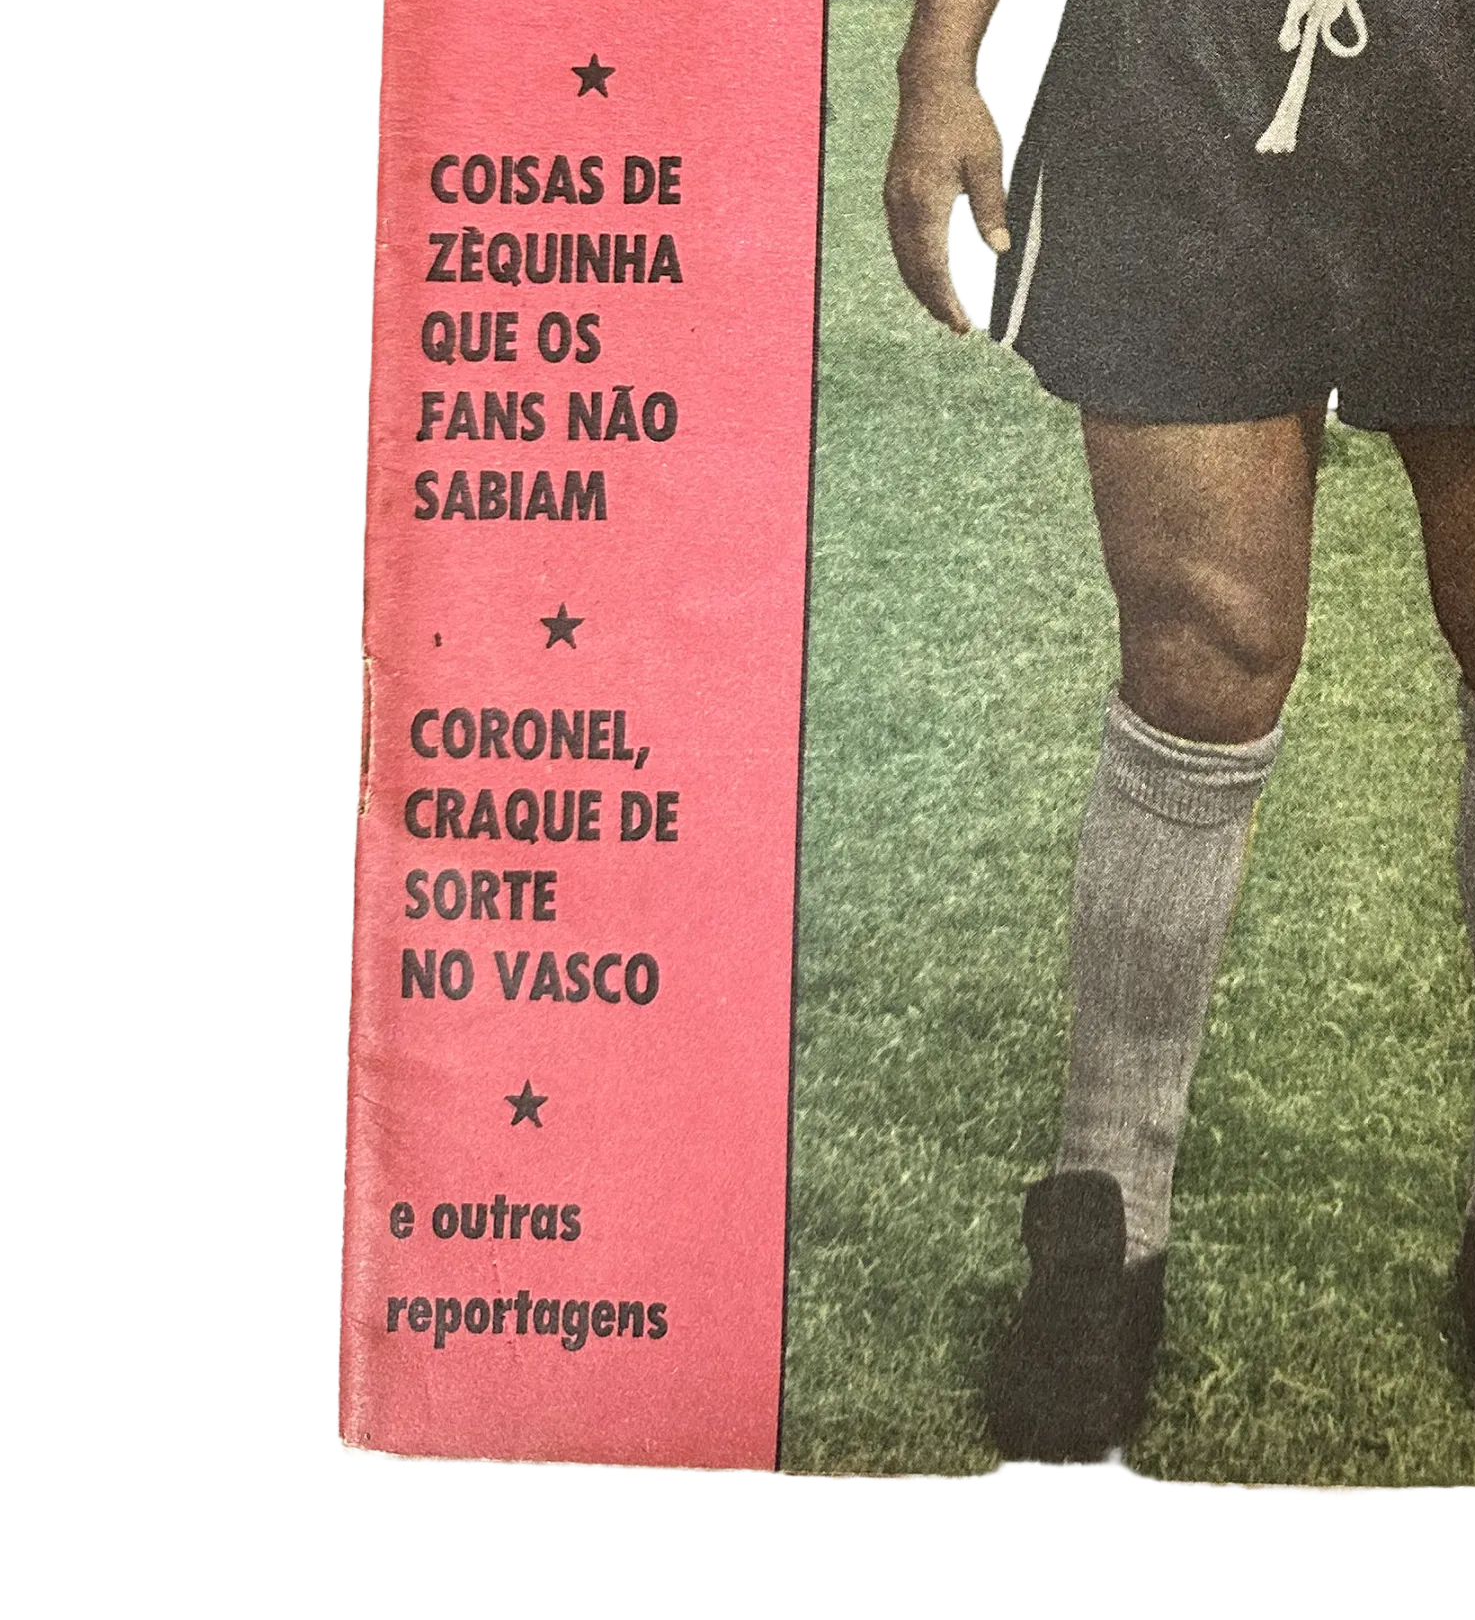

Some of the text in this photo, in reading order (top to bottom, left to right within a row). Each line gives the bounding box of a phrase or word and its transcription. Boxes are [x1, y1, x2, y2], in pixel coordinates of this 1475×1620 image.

[431, 154, 681, 204] COISAS DE
[422, 311, 600, 365] QUE OS
[416, 386, 677, 442] FANS NÃO
[414, 470, 606, 520] SABIAM
[411, 708, 649, 770] CORONEL,
[404, 789, 679, 844] CRAQUE DE
[406, 870, 556, 921] SORTE
[402, 949, 658, 1005] NO VASCO
[390, 1195, 580, 1241] e outras
[387, 1290, 667, 1351] reportagens
